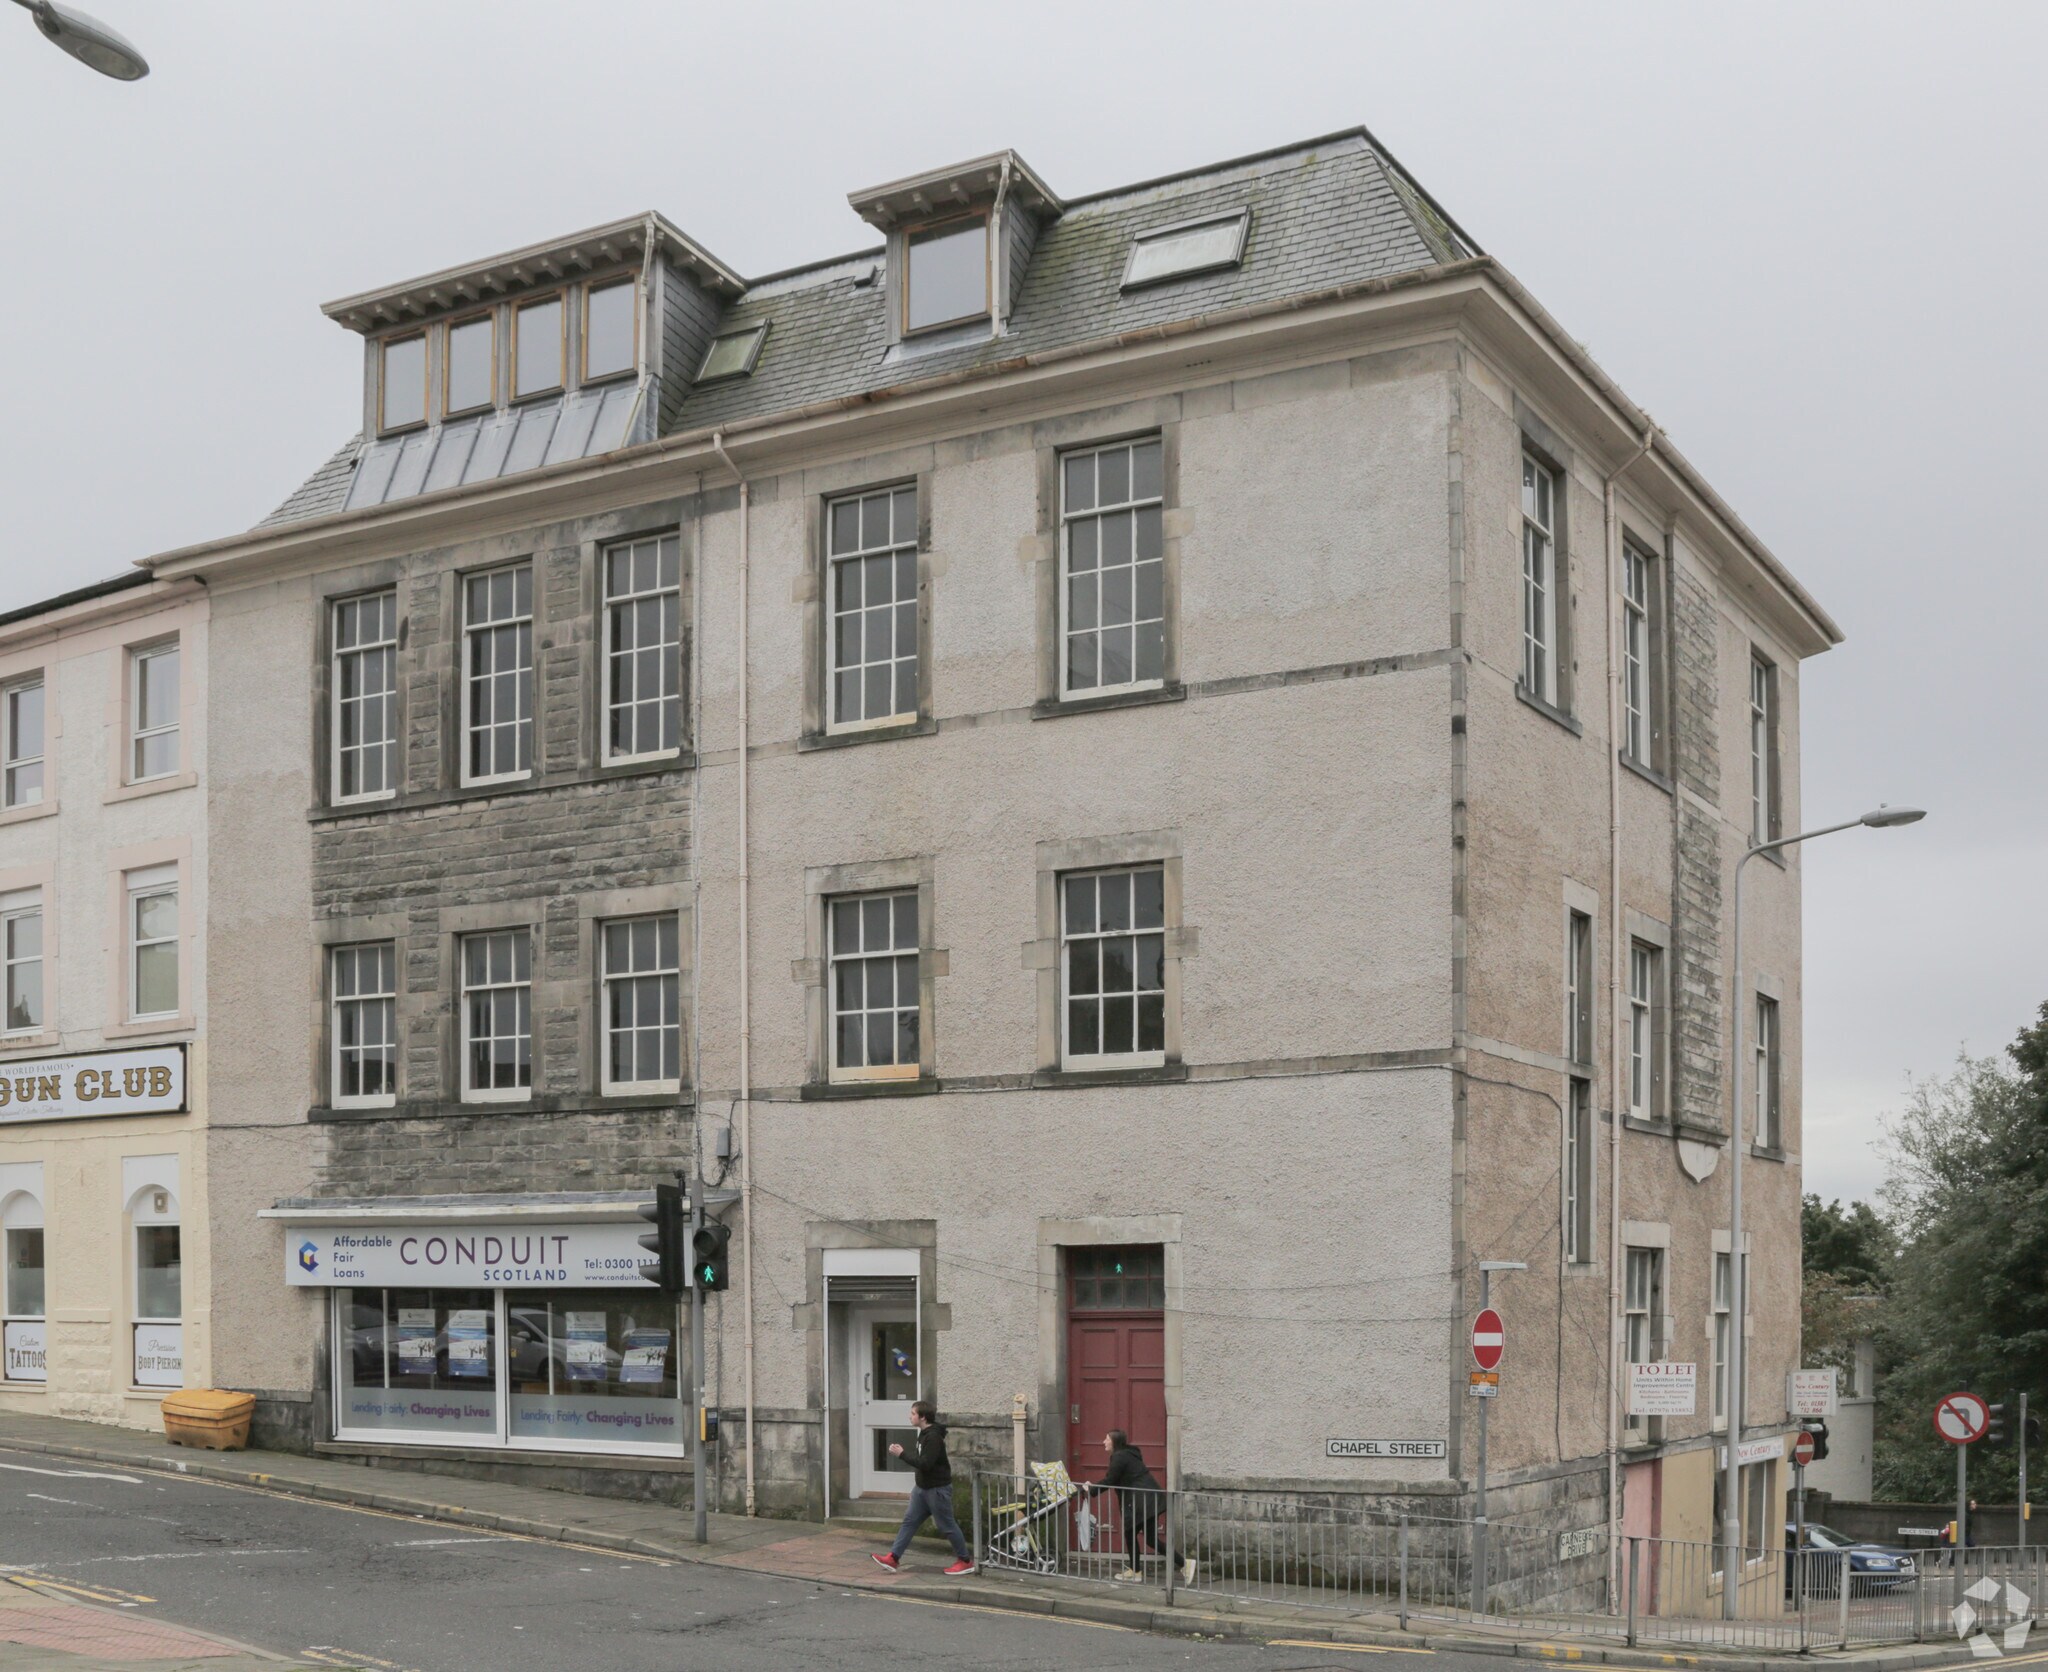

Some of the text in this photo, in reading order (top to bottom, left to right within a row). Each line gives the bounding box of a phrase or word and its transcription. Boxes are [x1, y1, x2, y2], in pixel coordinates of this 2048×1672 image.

[5, 1066, 35, 1075] WORLD
[74, 1066, 173, 1101] CLUB
[333, 1235, 393, 1248] Affordable
[400, 1235, 569, 1265] CONDUIT
[333, 1252, 354, 1263] Fair
[584, 1258, 602, 1269] Tel:
[604, 1258, 633, 1269] 0300
[333, 1267, 365, 1278] Loans
[483, 1269, 567, 1281] SCOTLAND
[138, 1356, 155, 1370] BODY
[1635, 1365, 1694, 1375] TO LET
[351, 1402, 382, 1416] Lending
[410, 1403, 461, 1419] Changing
[464, 1405, 491, 1418] Lives
[520, 1409, 554, 1423] Lending
[586, 1411, 642, 1427] Changing
[645, 1413, 674, 1426] Lives
[1330, 1442, 1441, 1455] CHAPEL STREET
